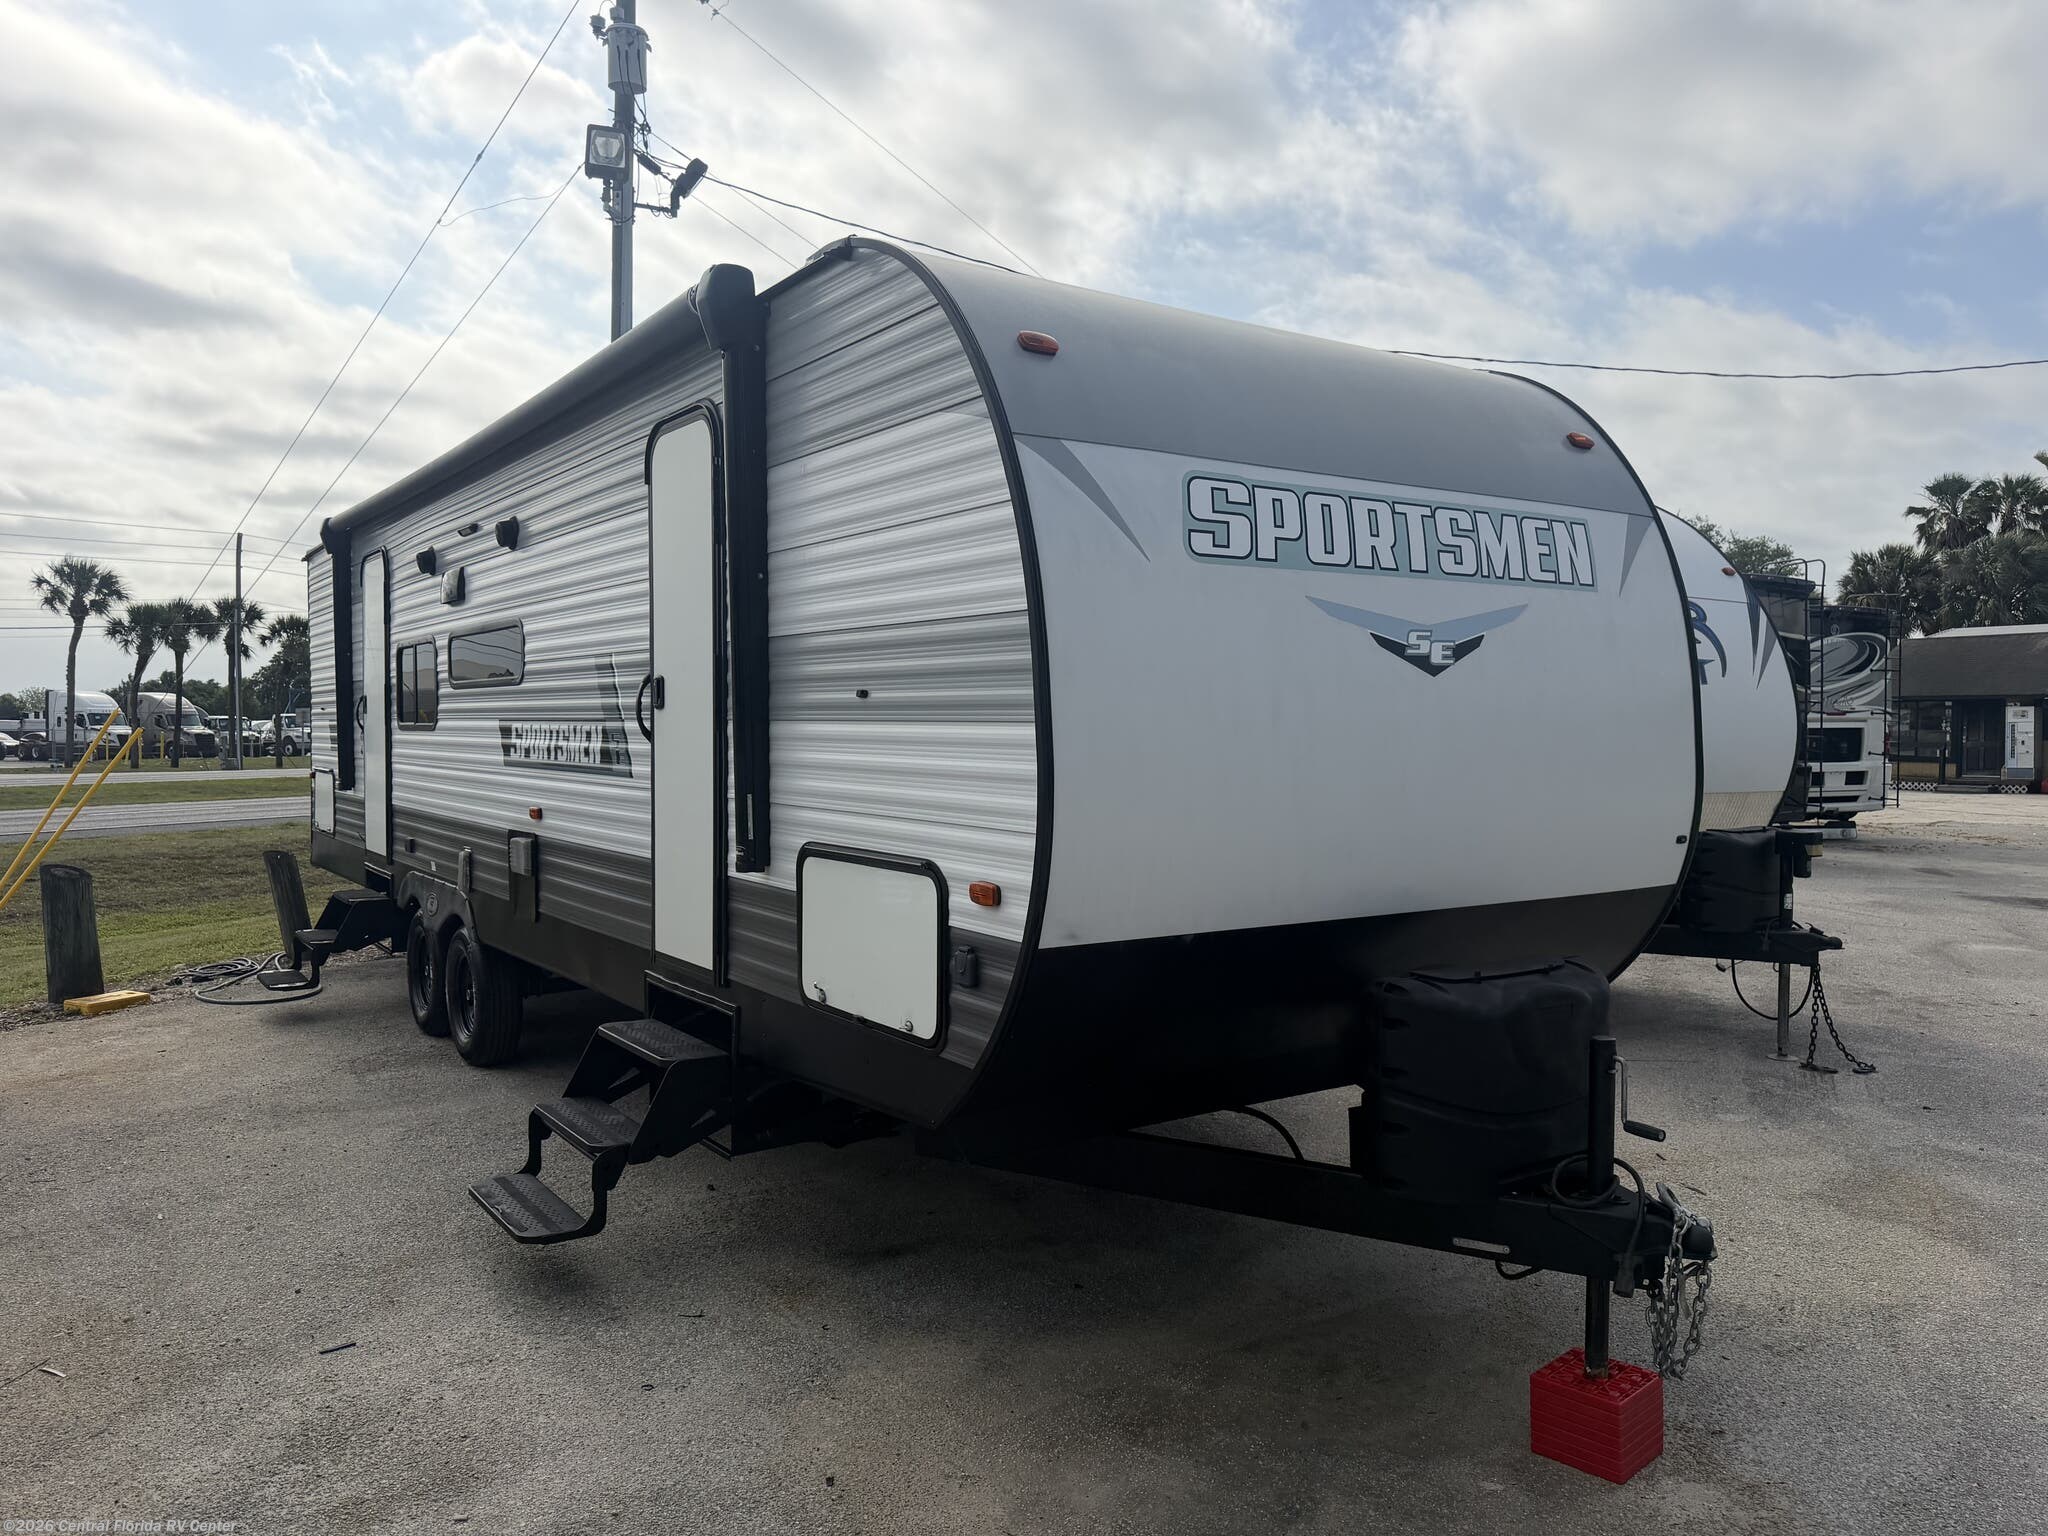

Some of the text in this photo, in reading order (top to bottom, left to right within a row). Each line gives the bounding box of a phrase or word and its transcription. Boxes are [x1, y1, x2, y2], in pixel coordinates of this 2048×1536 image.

[1186, 475, 1595, 587] SPORTSMEN
[1405, 629, 1456, 665] SE
[510, 724, 603, 764] SPORTSMEN
